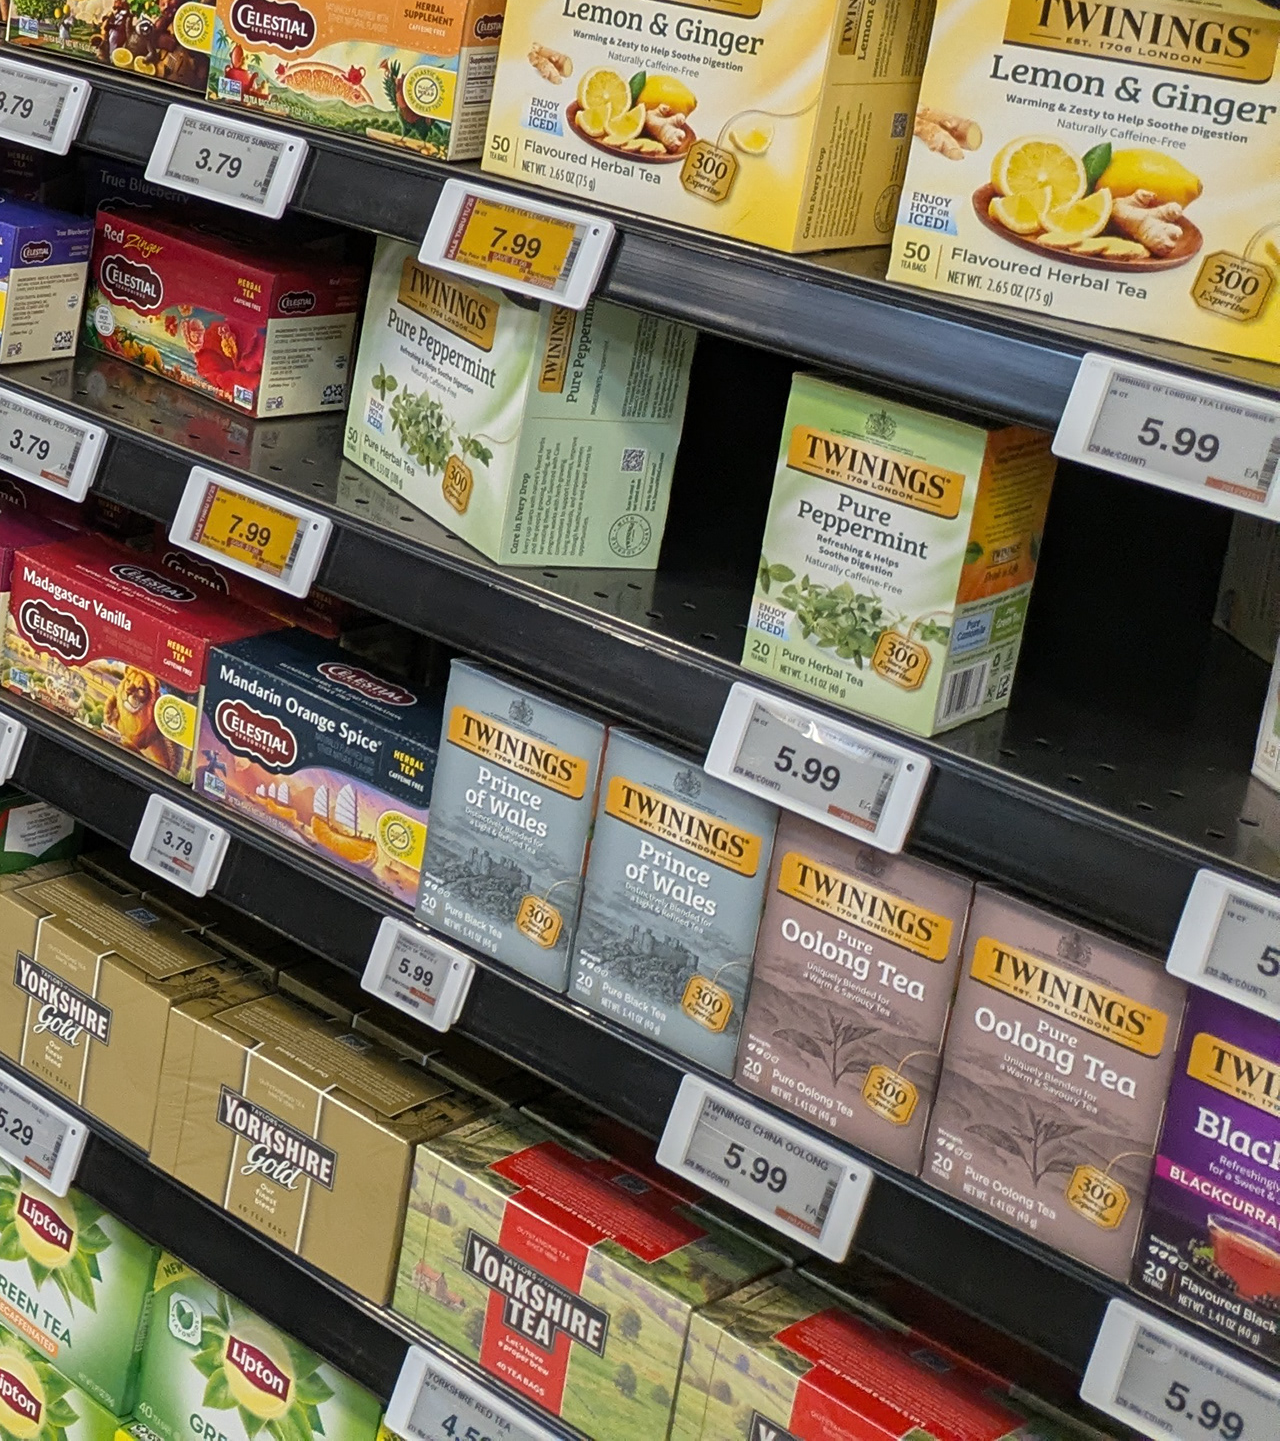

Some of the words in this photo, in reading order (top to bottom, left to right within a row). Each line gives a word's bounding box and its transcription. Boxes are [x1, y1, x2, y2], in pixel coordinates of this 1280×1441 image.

[990, 55, 1105, 98] Lemon
[1115, 78, 1140, 103] &
[1152, 83, 1277, 125] Ginger
[185, 120, 197, 128] CEL
[213, 127, 225, 136] TEA
[226, 130, 250, 143] CITRUS
[251, 138, 280, 151] SUNRISE
[1006, 93, 1058, 112] Warming
[1058, 103, 1067, 112] &
[1069, 105, 1100, 121] Zesty
[1102, 111, 1114, 121] to
[1117, 113, 1145, 129] Help
[1146, 118, 1188, 134] Soothe
[1191, 125, 1249, 145] Digestion
[195, 148, 242, 178] 3.79
[490, 226, 542, 259] 7.99
[10, 428, 51, 459] 3.79
[1139, 418, 1220, 464] 5.99
[806, 434, 945, 499] TWININGS
[229, 514, 271, 548] 7.99
[797, 500, 929, 561] Peppermint
[836, 495, 892, 527] Pure
[220, 664, 282, 707] Mandarin
[286, 698, 336, 734] Orange
[339, 722, 379, 753] Spice
[461, 713, 572, 784] TWININGS
[775, 748, 841, 791] 5.99
[476, 767, 542, 812] Prince
[465, 788, 486, 810] of
[488, 794, 550, 841] Wales
[797, 861, 935, 942] TWININGS
[780, 918, 871, 980] Oolong
[878, 961, 927, 1005] Tea
[18, 966, 110, 1042] YORKSHIRE
[33, 1004, 80, 1046] Gold
[724, 1142, 787, 1193] 5.99
[753, 1125, 783, 1147] CHINA
[785, 1142, 829, 1170] OOLONG
[469, 1241, 603, 1351] YORKSHIRE
[507, 1299, 554, 1345] TEA
